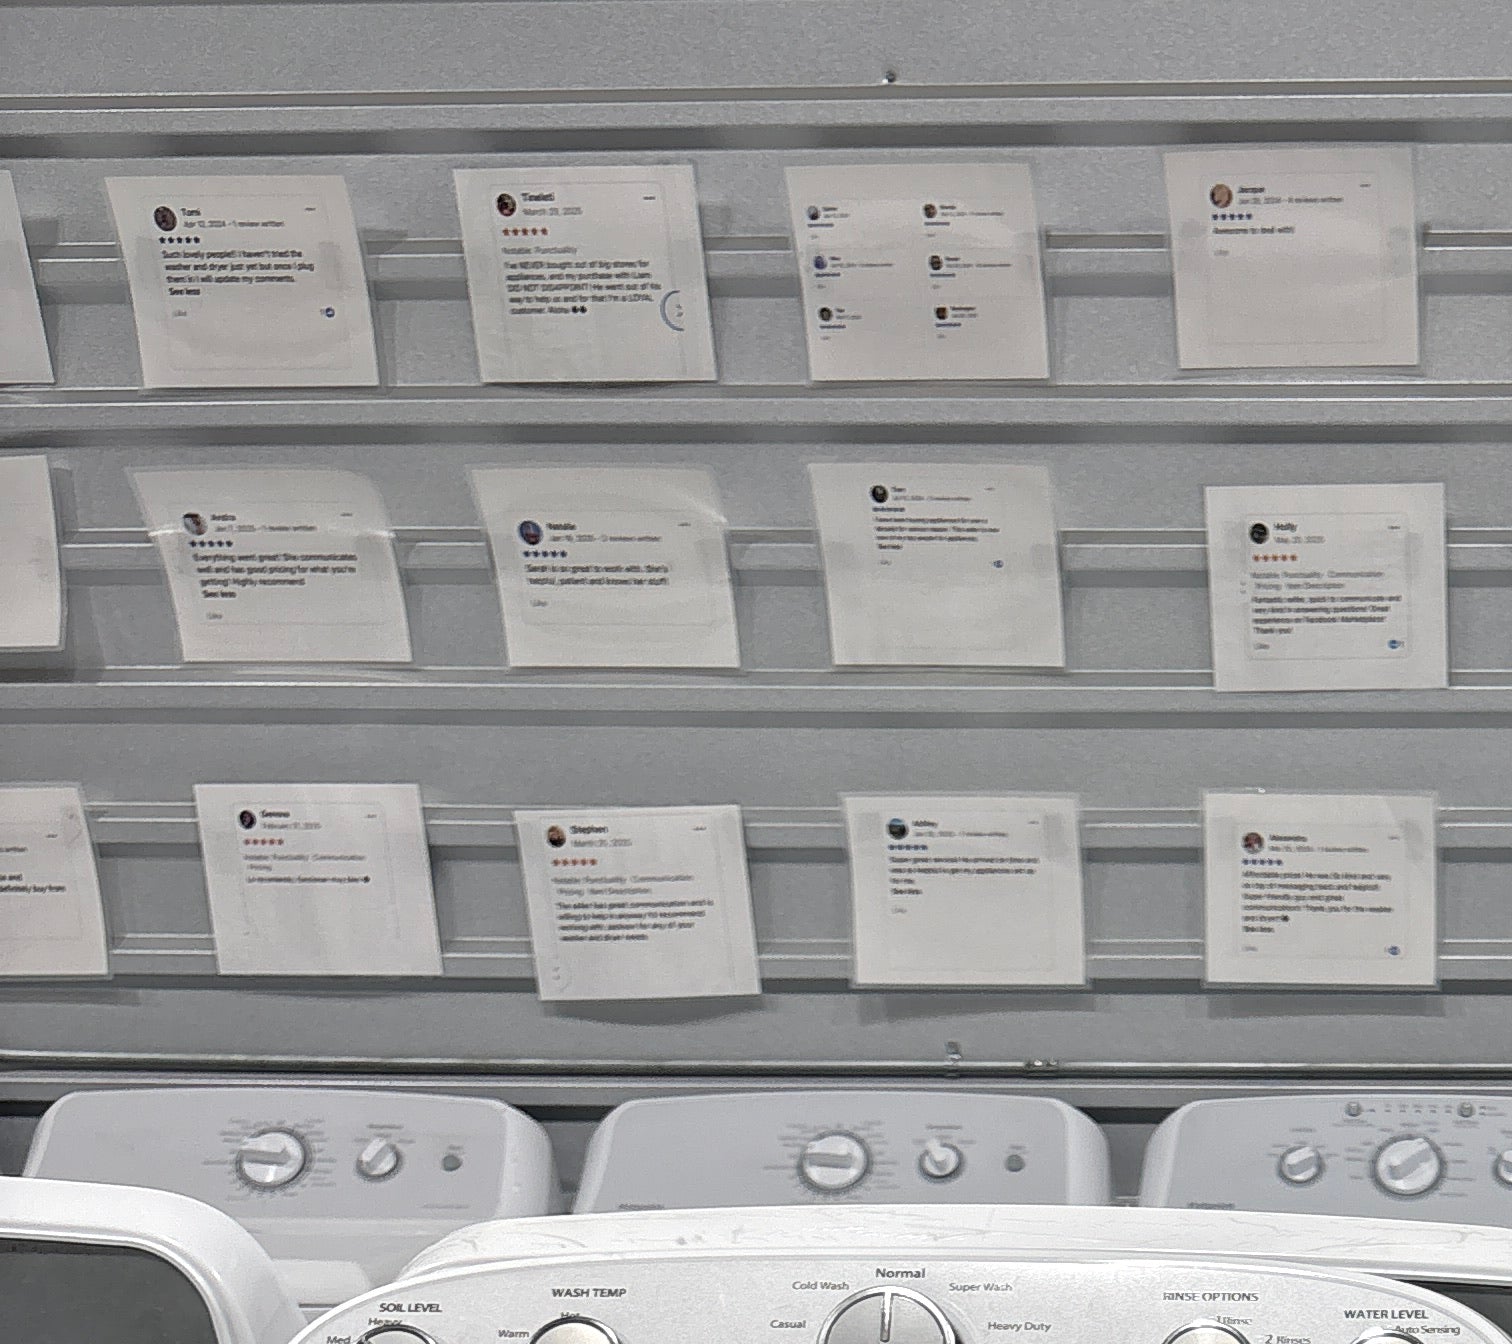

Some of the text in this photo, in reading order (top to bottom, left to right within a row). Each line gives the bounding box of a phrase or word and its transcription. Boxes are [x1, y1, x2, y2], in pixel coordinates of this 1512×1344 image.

[876, 1268, 925, 1278] Normal
[792, 1281, 849, 1290] Cold Wash
[949, 1283, 980, 1293] Super
[552, 1288, 626, 1297] WASH TEMP
[1163, 1292, 1259, 1301] RINSE OPTIONS
[379, 1303, 442, 1312] SOIL LEVEL
[1344, 1310, 1428, 1319] WATER LEVEL
[770, 1320, 806, 1328] Casual
[988, 1322, 1051, 1332] Heavy Duty
[498, 1329, 529, 1338] Warm
[1395, 1325, 1460, 1336] Auto Sensing
[327, 1336, 351, 1344] Med
[1265, 1335, 1311, 1344] 2 Rinses
